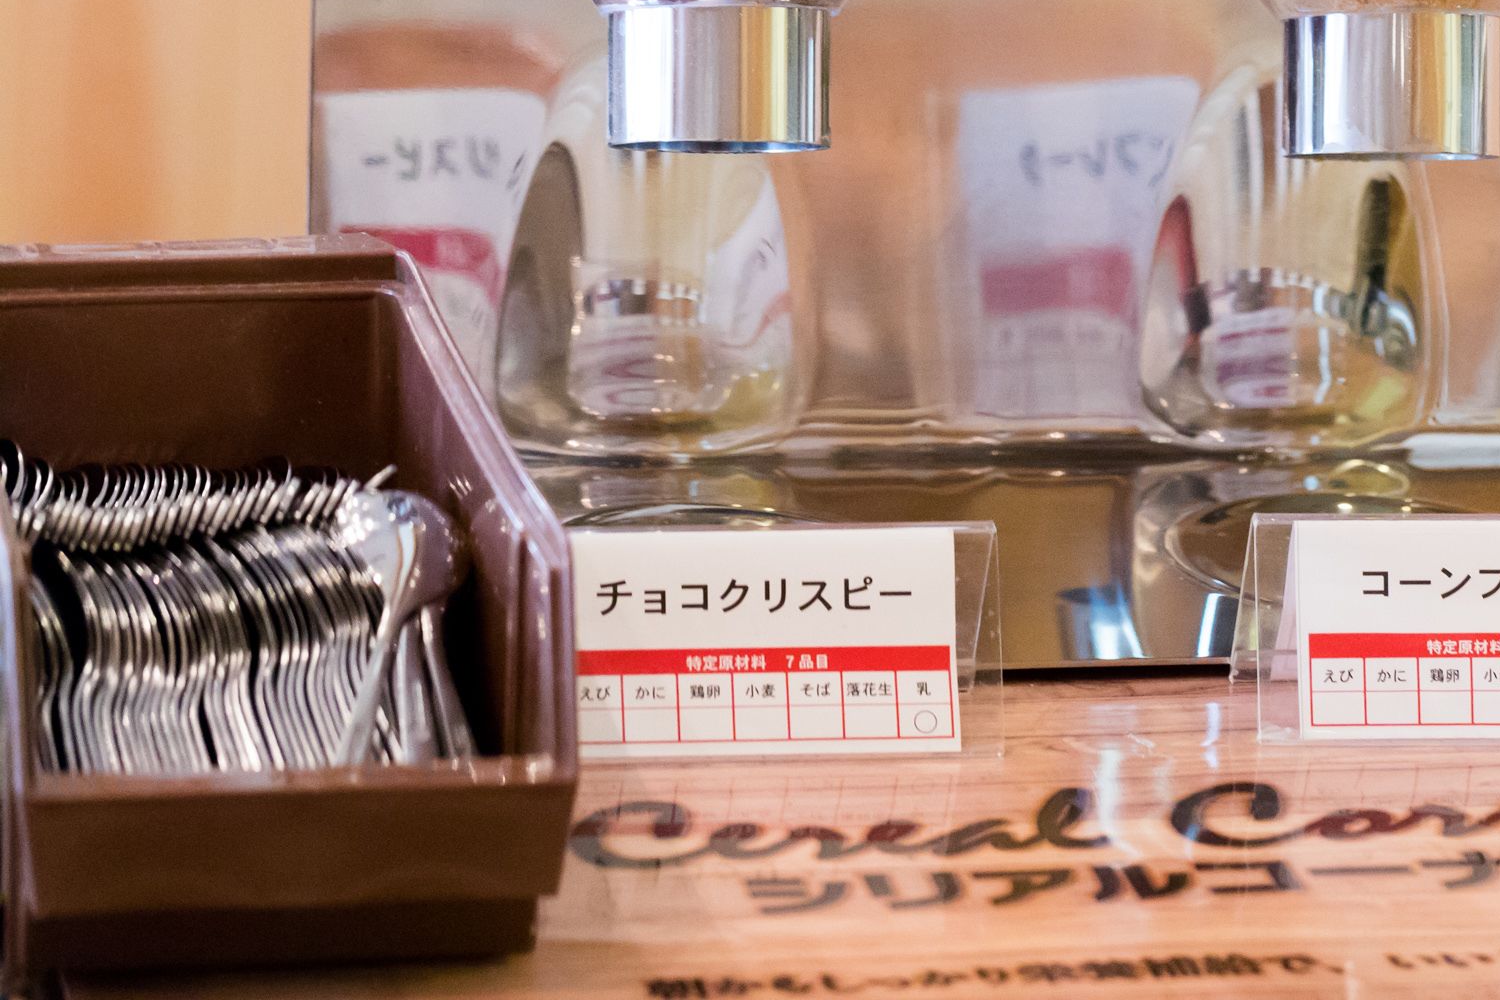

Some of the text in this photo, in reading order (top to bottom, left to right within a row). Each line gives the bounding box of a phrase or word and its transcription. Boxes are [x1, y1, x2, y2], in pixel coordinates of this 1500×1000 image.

[596, 575, 912, 616] チョコクリスピー
[685, 653, 828, 671] 特定原材料 7品目
[1323, 668, 1354, 684] えび
[1377, 669, 1407, 683] かに
[1430, 668, 1460, 683] 鶏卵
[580, 686, 611, 701] えび
[635, 685, 666, 700] かに
[690, 685, 721, 700] 鶏卵
[745, 683, 776, 699] 小麦
[800, 682, 831, 697] そば
[846, 682, 893, 698] 落花生
[916, 682, 931, 696] 乳
[570, 786, 1112, 869] Cereal
